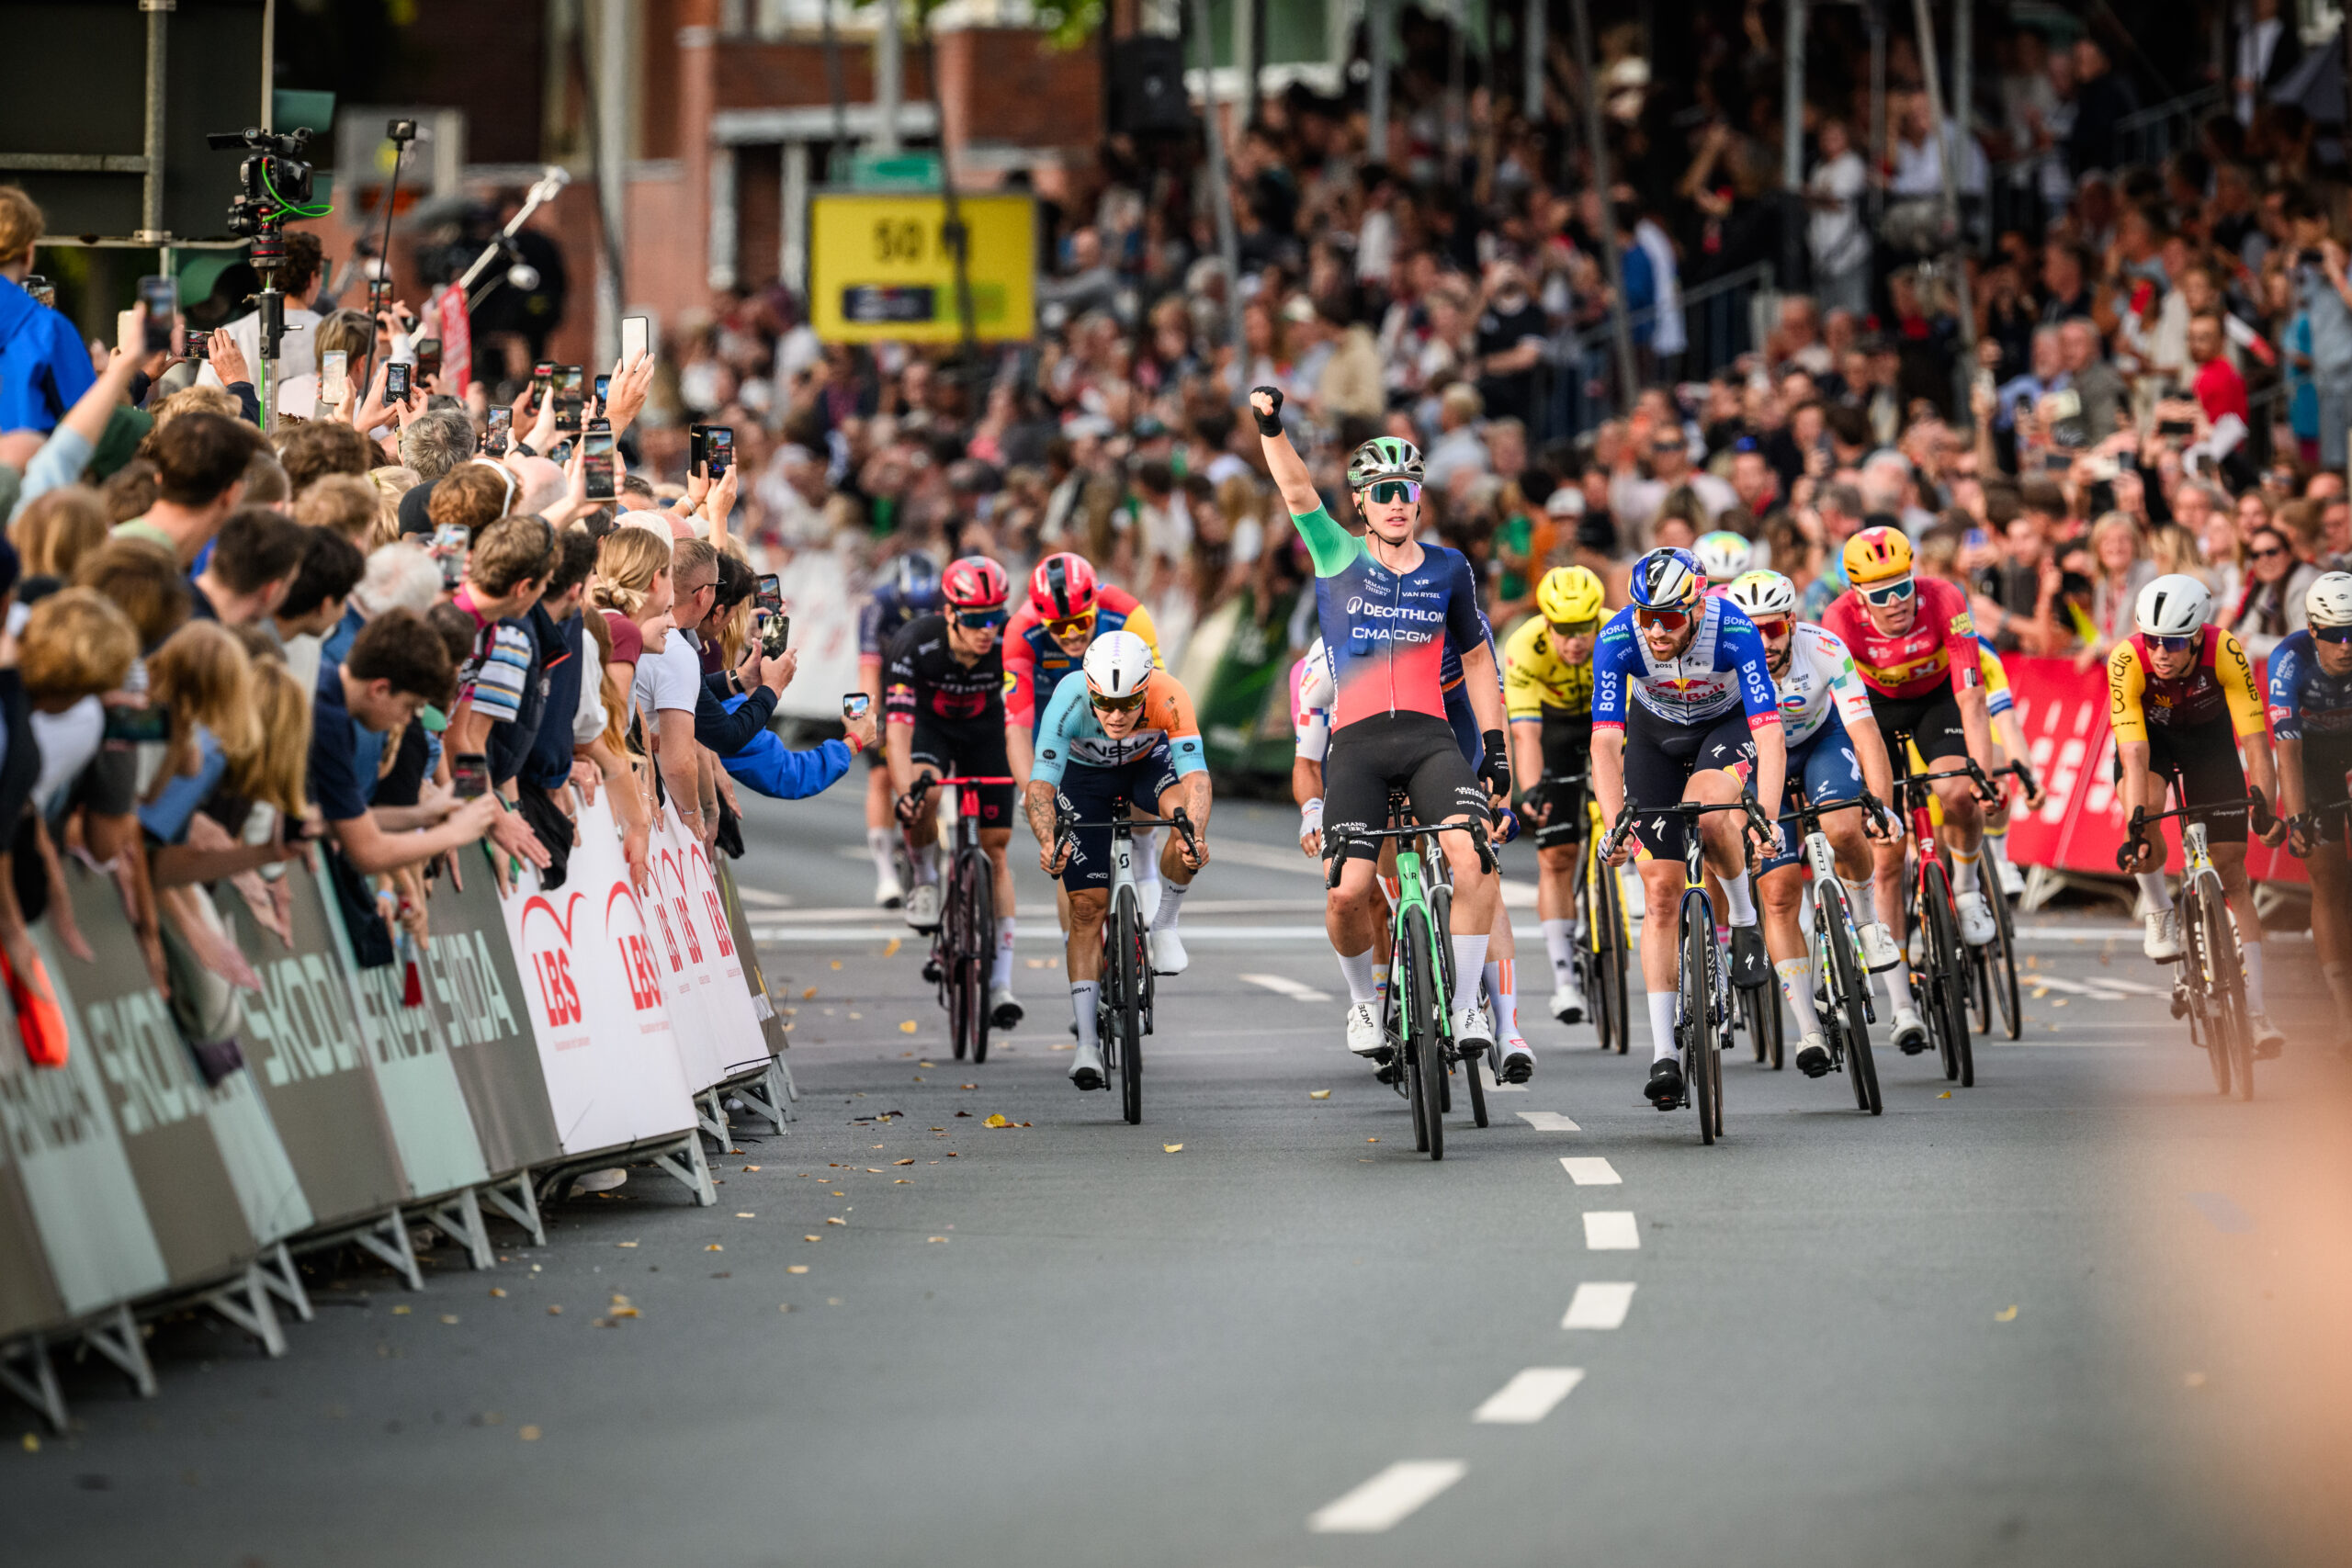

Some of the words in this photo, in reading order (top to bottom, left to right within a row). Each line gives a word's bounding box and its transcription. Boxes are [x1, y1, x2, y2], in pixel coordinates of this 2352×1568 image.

[1363, 578, 1391, 594] ARMAND
[1419, 592, 1441, 600] RYSEL
[1363, 602, 1445, 624] DECATHLON
[1600, 623, 1629, 639] BORA
[1724, 615, 1753, 628] BORA
[1599, 670, 1618, 712] BOSS
[1645, 685, 1683, 700] Red
[1686, 682, 1724, 702] Bull
[1741, 659, 1770, 704] BOSS
[1814, 836, 1826, 872] CUBE
[672, 895, 704, 965] LBS
[702, 888, 735, 957] LBS
[532, 947, 582, 1029] LBS
[616, 932, 662, 1011] LBS
